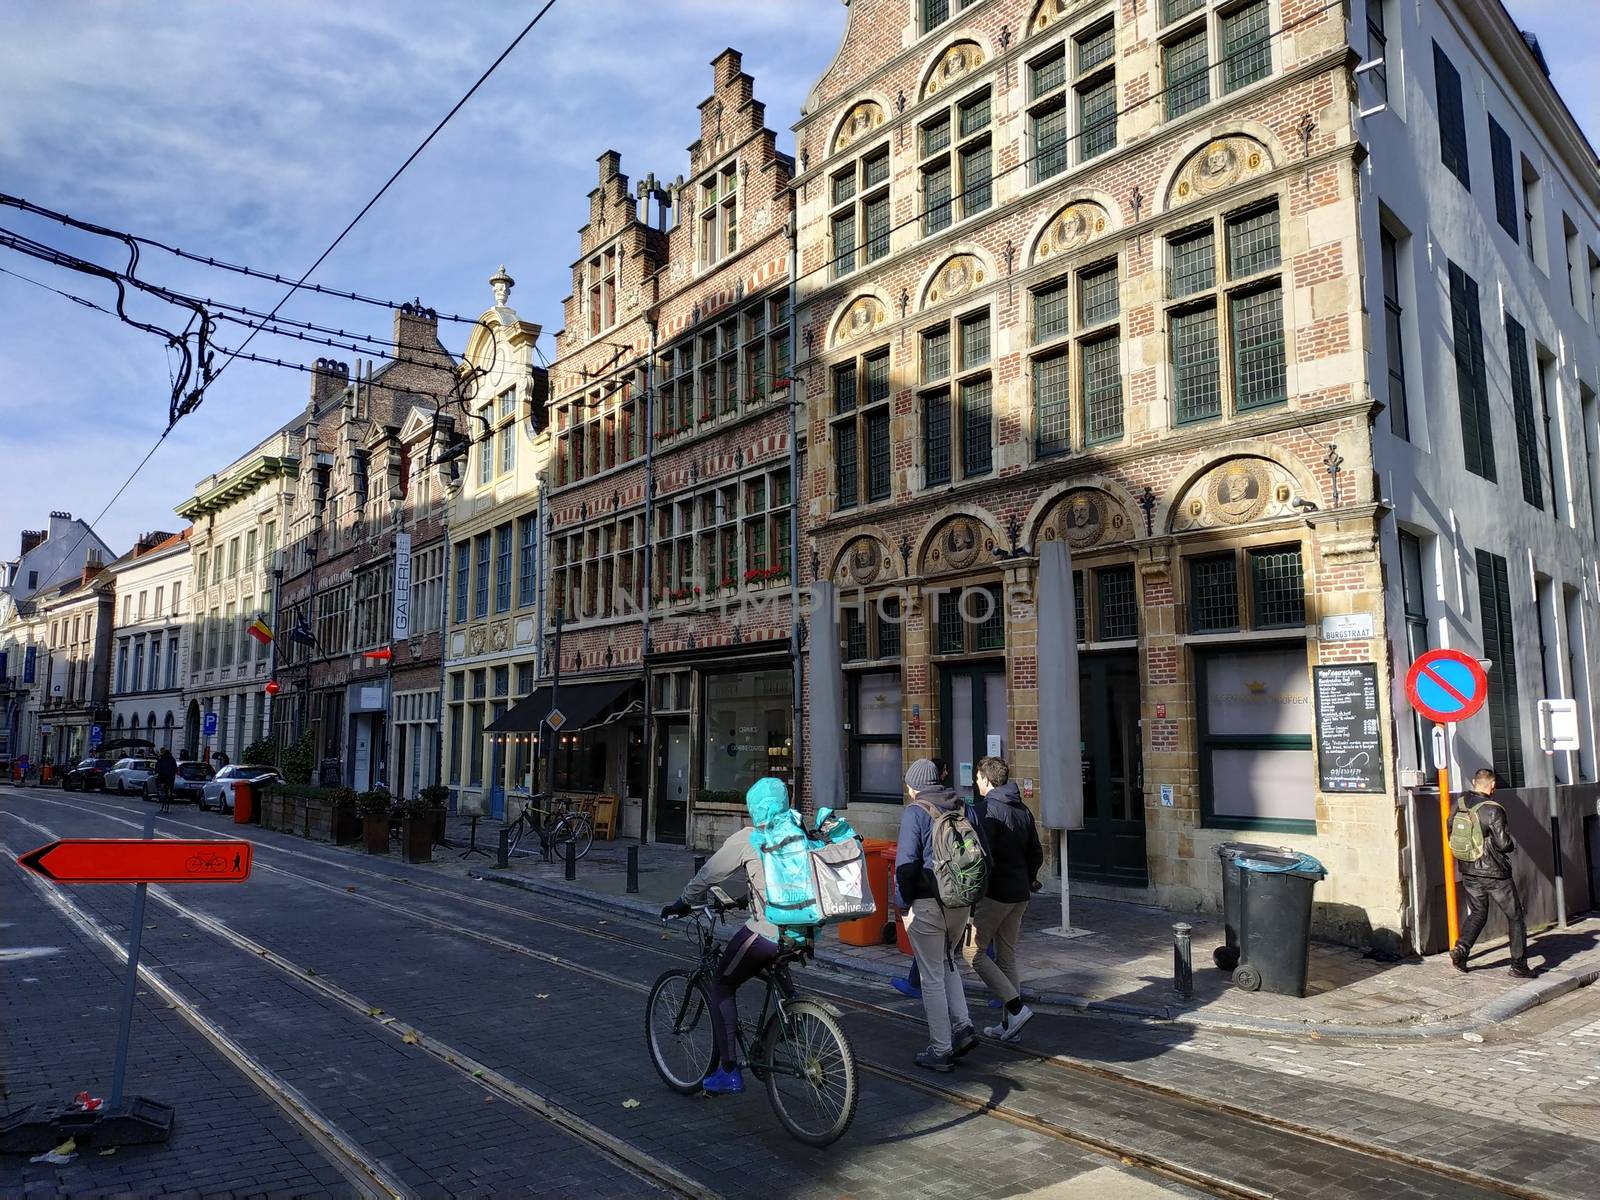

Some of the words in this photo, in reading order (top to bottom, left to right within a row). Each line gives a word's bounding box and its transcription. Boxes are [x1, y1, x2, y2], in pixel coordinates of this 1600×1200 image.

[1179, 182, 1189, 197] K
[1249, 154, 1260, 168] B
[1096, 219, 1104, 231] B
[1192, 502, 1201, 512] P
[1278, 486, 1288, 500] F
[396, 553, 410, 630] GALERIJ
[1326, 628, 1370, 640] BURGSTRAAT
[206, 715, 216, 727] P
[92, 726, 100, 736] P
